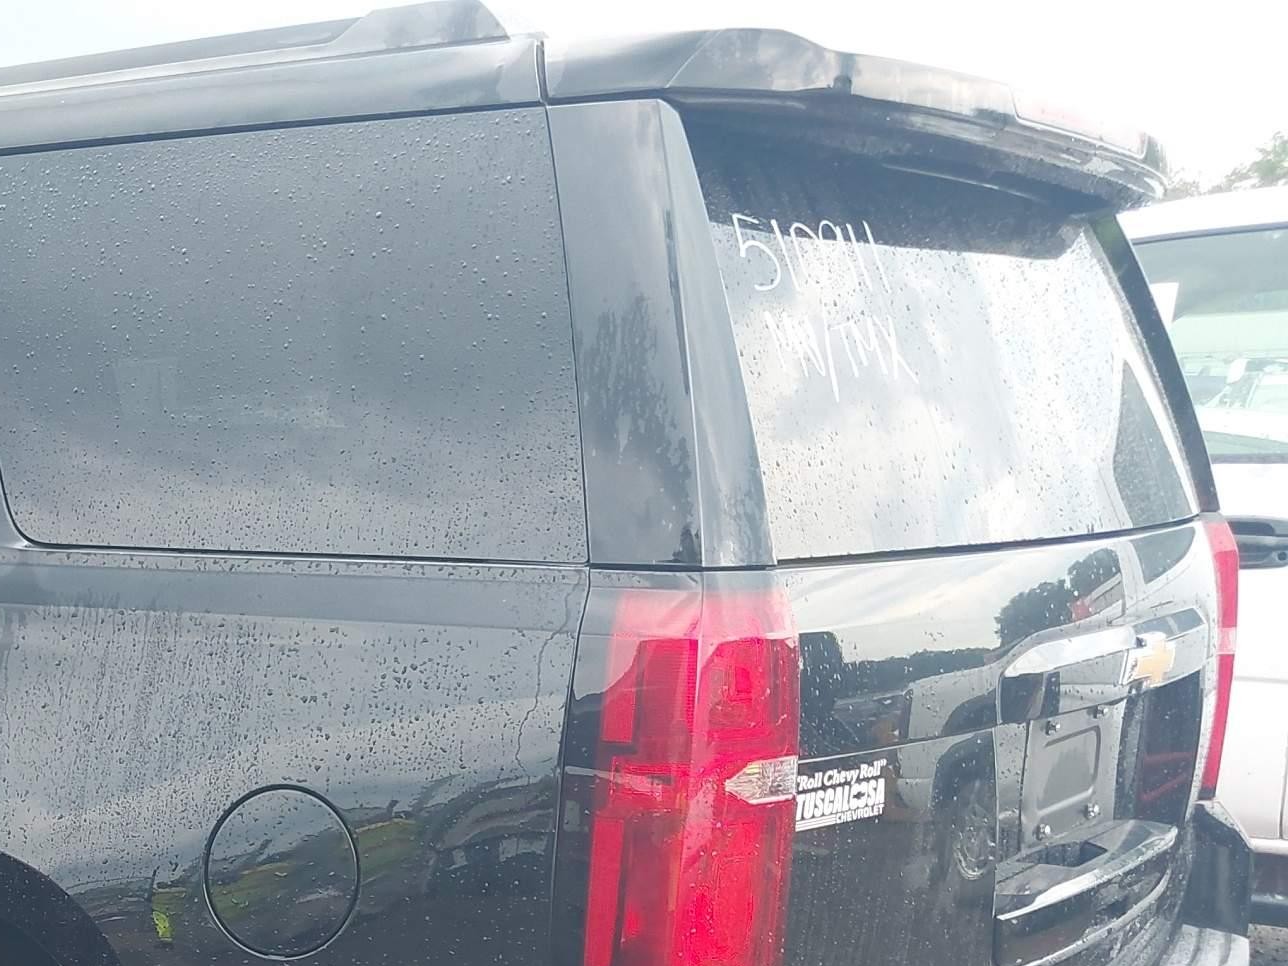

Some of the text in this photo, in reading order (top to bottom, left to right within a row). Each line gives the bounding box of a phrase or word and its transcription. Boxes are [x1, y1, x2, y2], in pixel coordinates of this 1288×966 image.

[823, 768, 859, 786] Chevy
[795, 778, 885, 821] TUSCALOOSA
[835, 804, 885, 824] CHEVROLET
